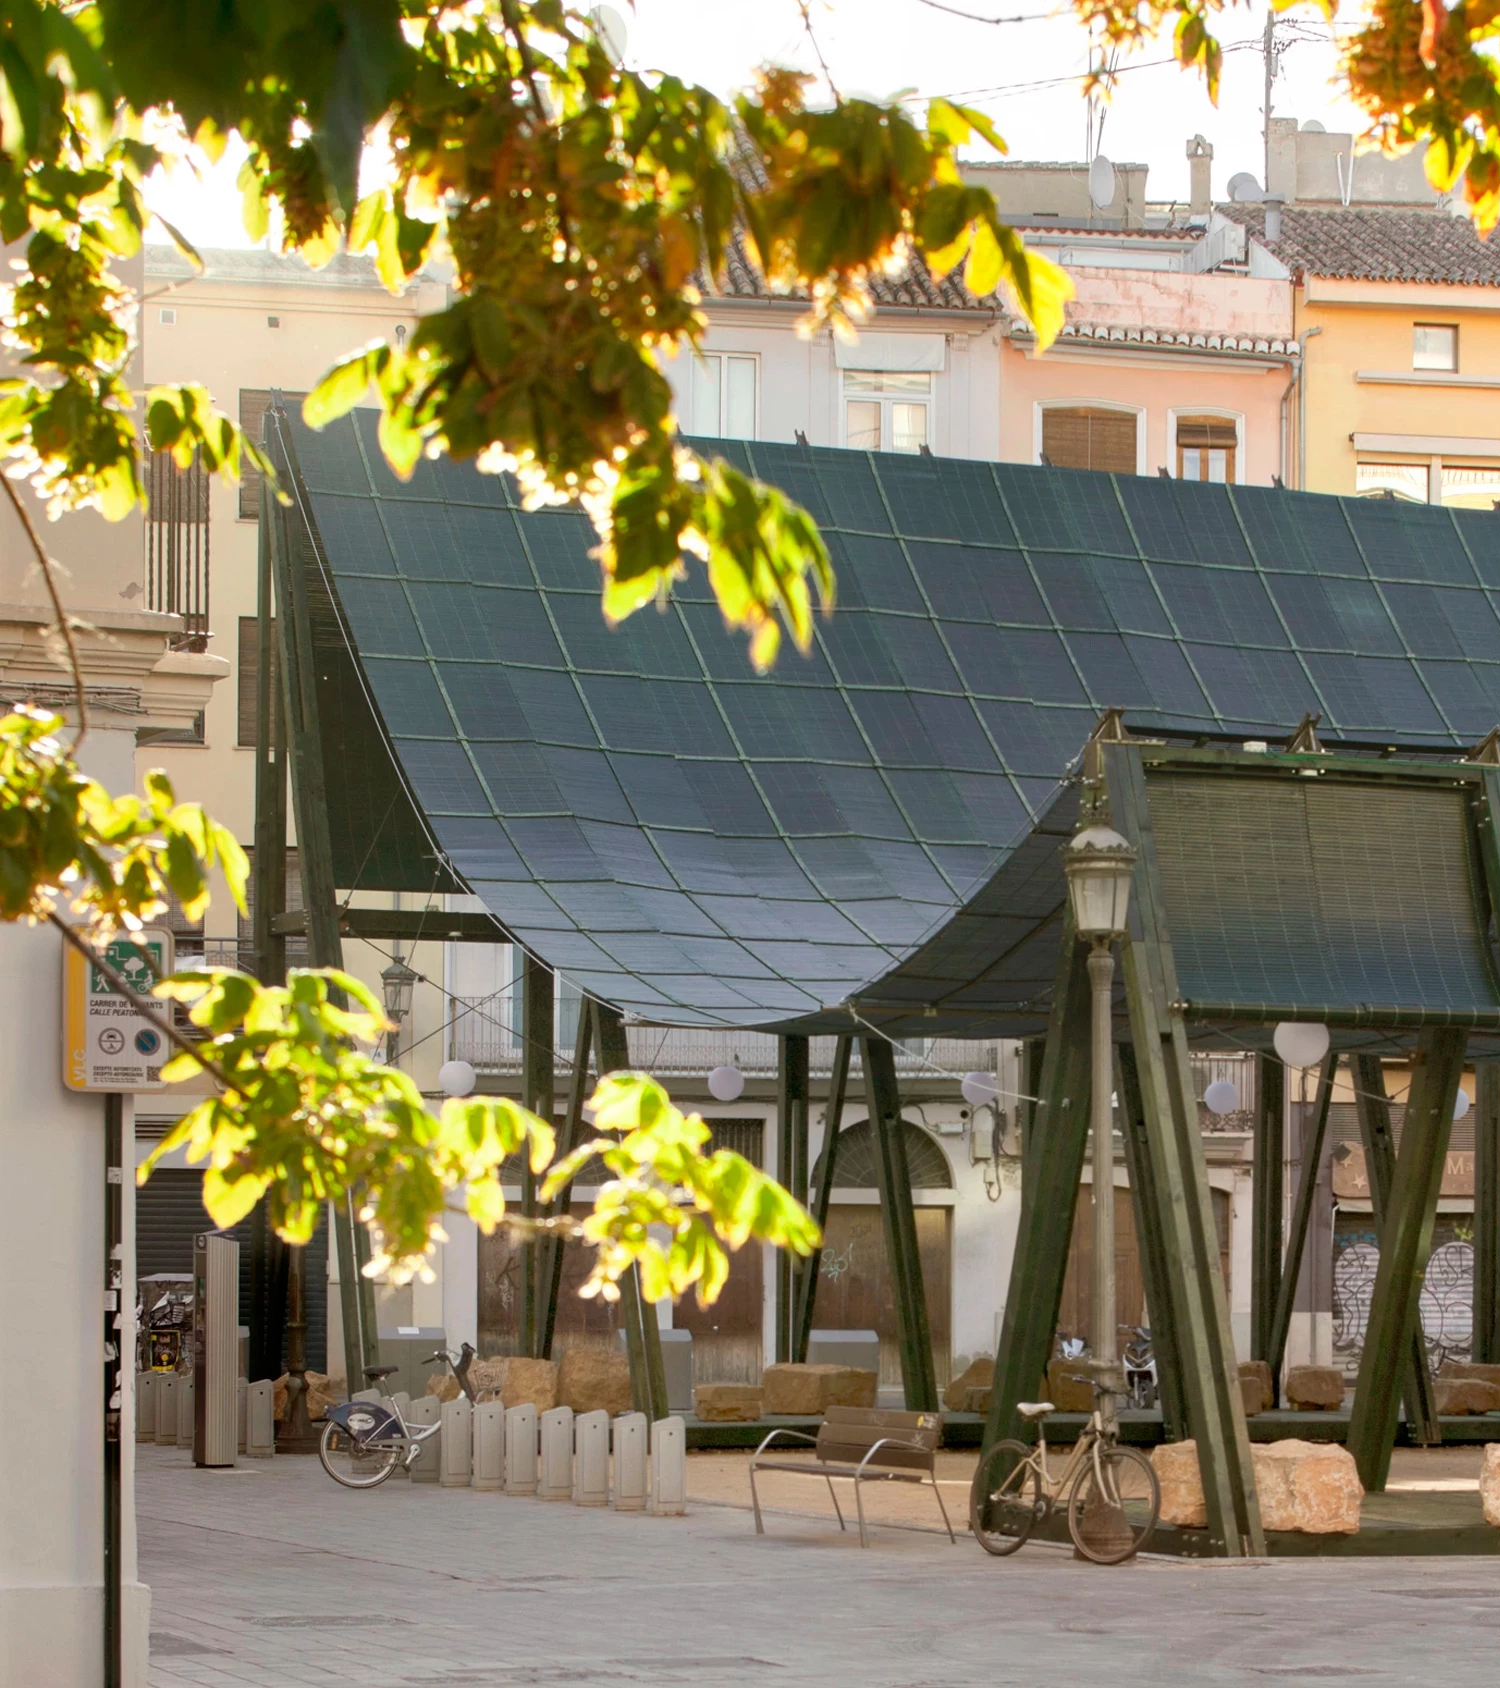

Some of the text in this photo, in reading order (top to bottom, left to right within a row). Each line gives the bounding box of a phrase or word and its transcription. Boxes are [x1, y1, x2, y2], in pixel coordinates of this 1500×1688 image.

[90, 1000, 117, 1008] CARRER
[118, 1001, 129, 1009] DE
[90, 1009, 111, 1017] CALLE
[73, 1049, 86, 1082] VLC
